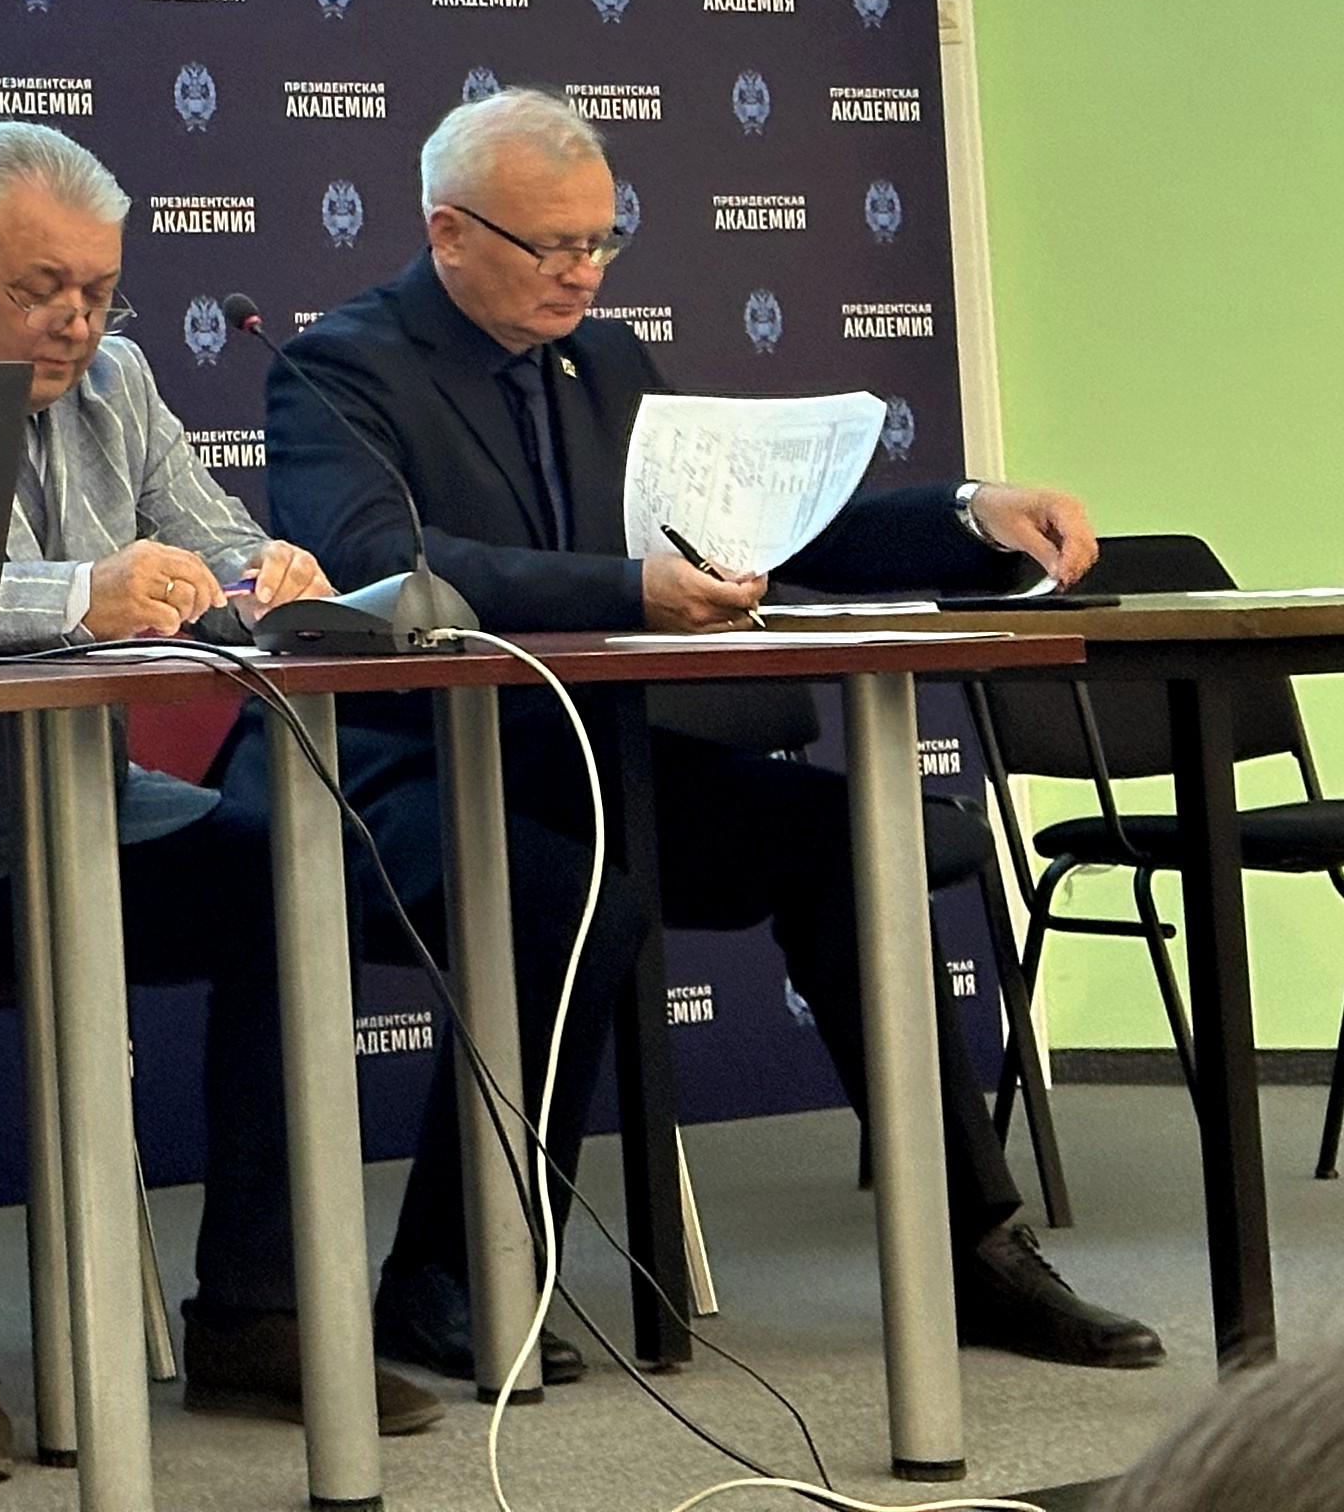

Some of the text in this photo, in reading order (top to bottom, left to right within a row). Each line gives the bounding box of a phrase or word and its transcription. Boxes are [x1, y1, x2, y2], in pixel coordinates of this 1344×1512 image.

[285, 82, 384, 93] ПРЕЗИДЕНТСКАЯ
[566, 84, 660, 96] ПРЕЗИДЕНТСКАЯ
[830, 88, 919, 98] ПРЕЗИДЕНТСКАЯ
[287, 96, 385, 118] АКАДЕМИЯ
[569, 98, 662, 120] АКАДЕМИЯ
[832, 101, 920, 121] АКАДЕМИЯ
[151, 197, 254, 207] ПРЕЗИДЕНТСКАЯ
[713, 196, 805, 206] ПРЕЗИДЕНТСКАЯ
[152, 211, 255, 232] АКАДЕМИЯ
[715, 209, 806, 229] АКАДЕМИЯ
[585, 307, 671, 319] РЕЗИДЕНТСКАЯ
[842, 304, 931, 314] ПРЕЗИДЕНТСКАЯ
[844, 317, 933, 338] АКАДЕМИЯ
[186, 430, 266, 443] ЗИДЕНТСКАЯ
[199, 444, 267, 468] ДЕМИЯ
[356, 1011, 432, 1029] ИДЕНТСКАЯ
[355, 1026, 433, 1056] АДЕМИЯ
